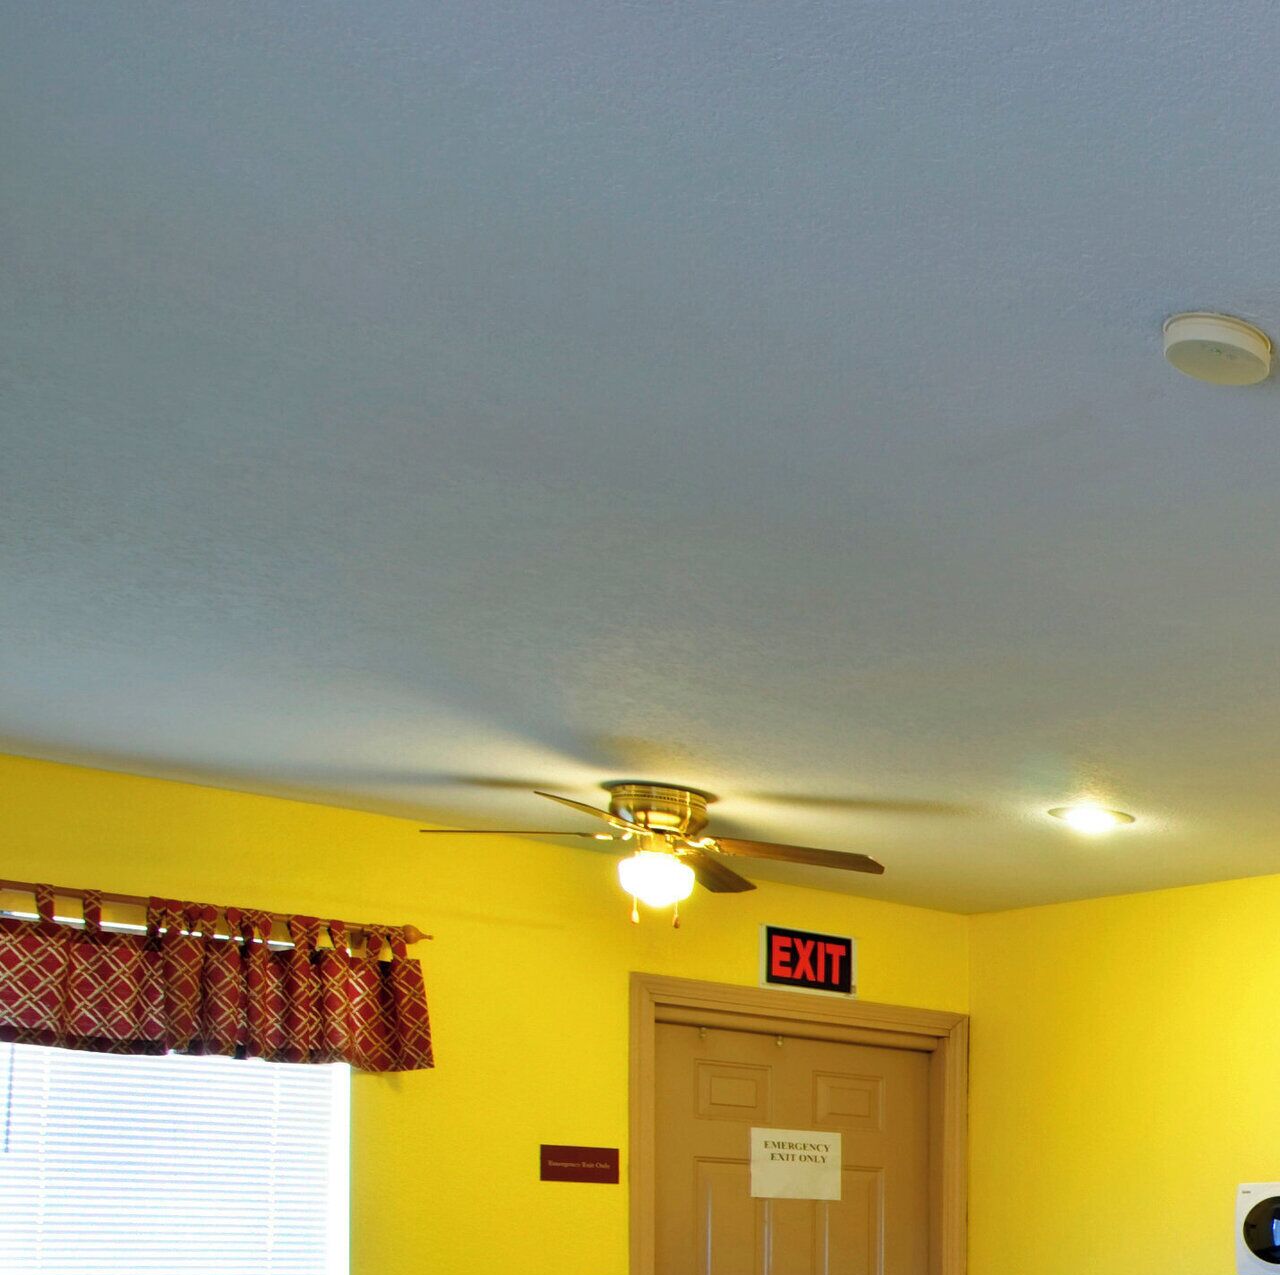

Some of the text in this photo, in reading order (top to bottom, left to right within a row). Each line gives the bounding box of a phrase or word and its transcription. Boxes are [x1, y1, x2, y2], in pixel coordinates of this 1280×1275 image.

[772, 934, 846, 985] EXIT
[764, 1141, 831, 1152] EMERGENCY
[770, 1153, 827, 1163] EXIT ONLY
